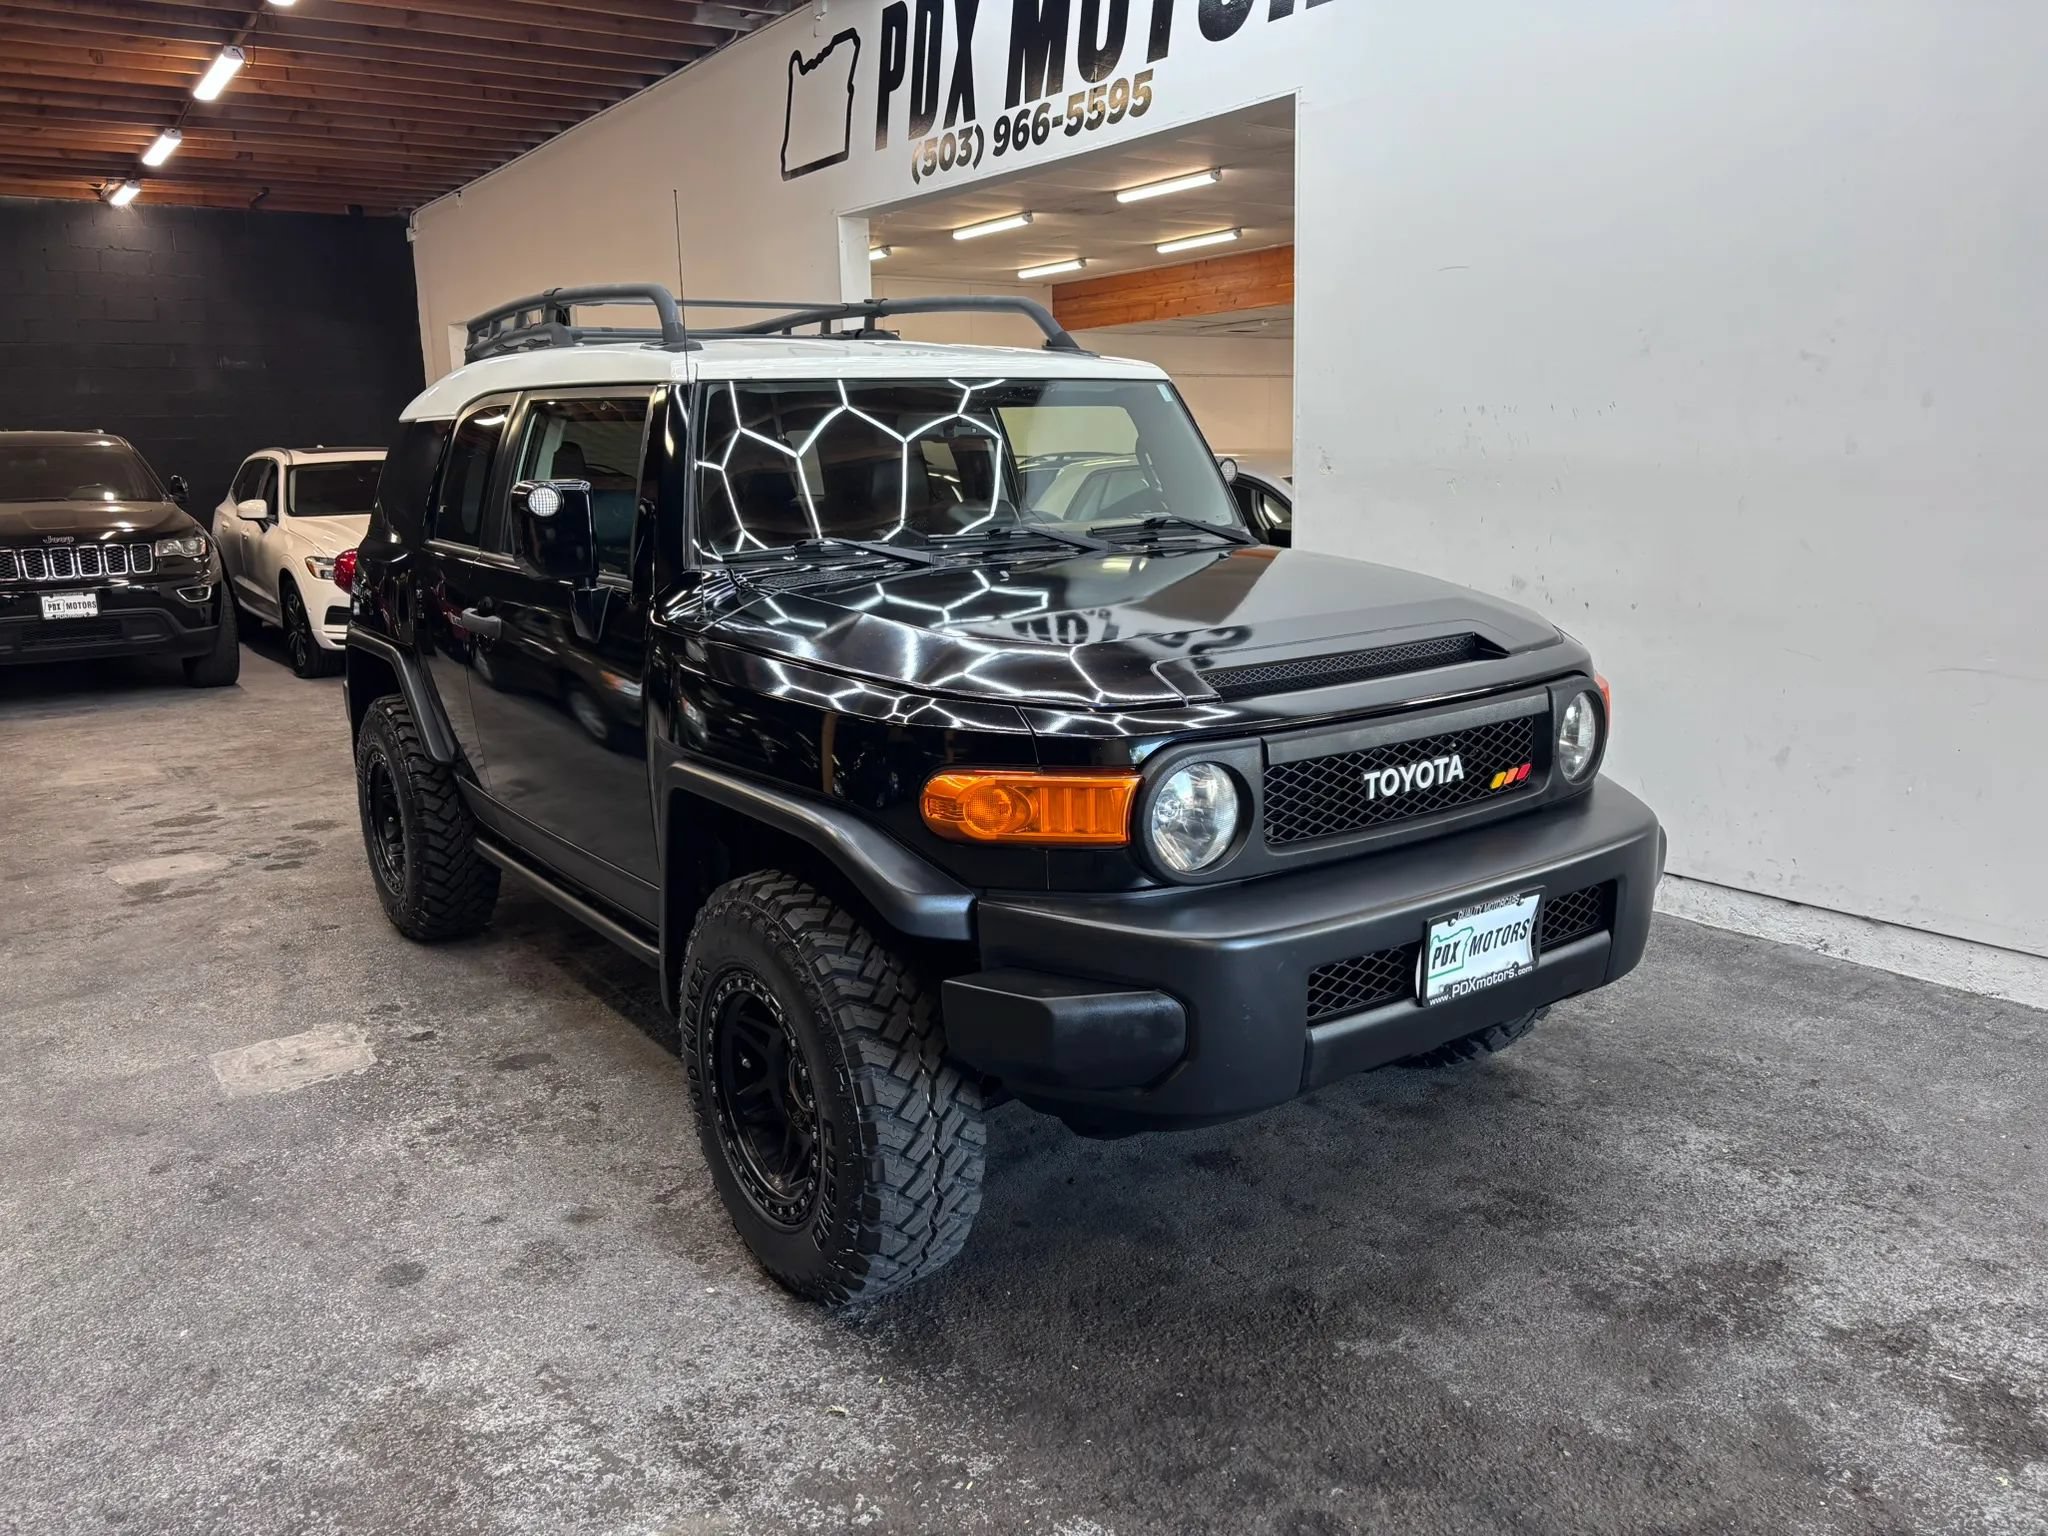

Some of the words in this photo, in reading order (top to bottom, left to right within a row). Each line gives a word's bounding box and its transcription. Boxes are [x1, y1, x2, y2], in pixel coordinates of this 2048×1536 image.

[875, 0, 979, 151] PDX
[911, 123, 985, 184] (503)
[993, 69, 1154, 157] 966-5595
[66, 601, 97, 610] MOTORS
[1363, 754, 1465, 800] TOYOTA
[1432, 940, 1461, 970] PDX
[1469, 918, 1530, 957] MOTORS
[1429, 966, 1533, 1006] www.PDXmotors.com
